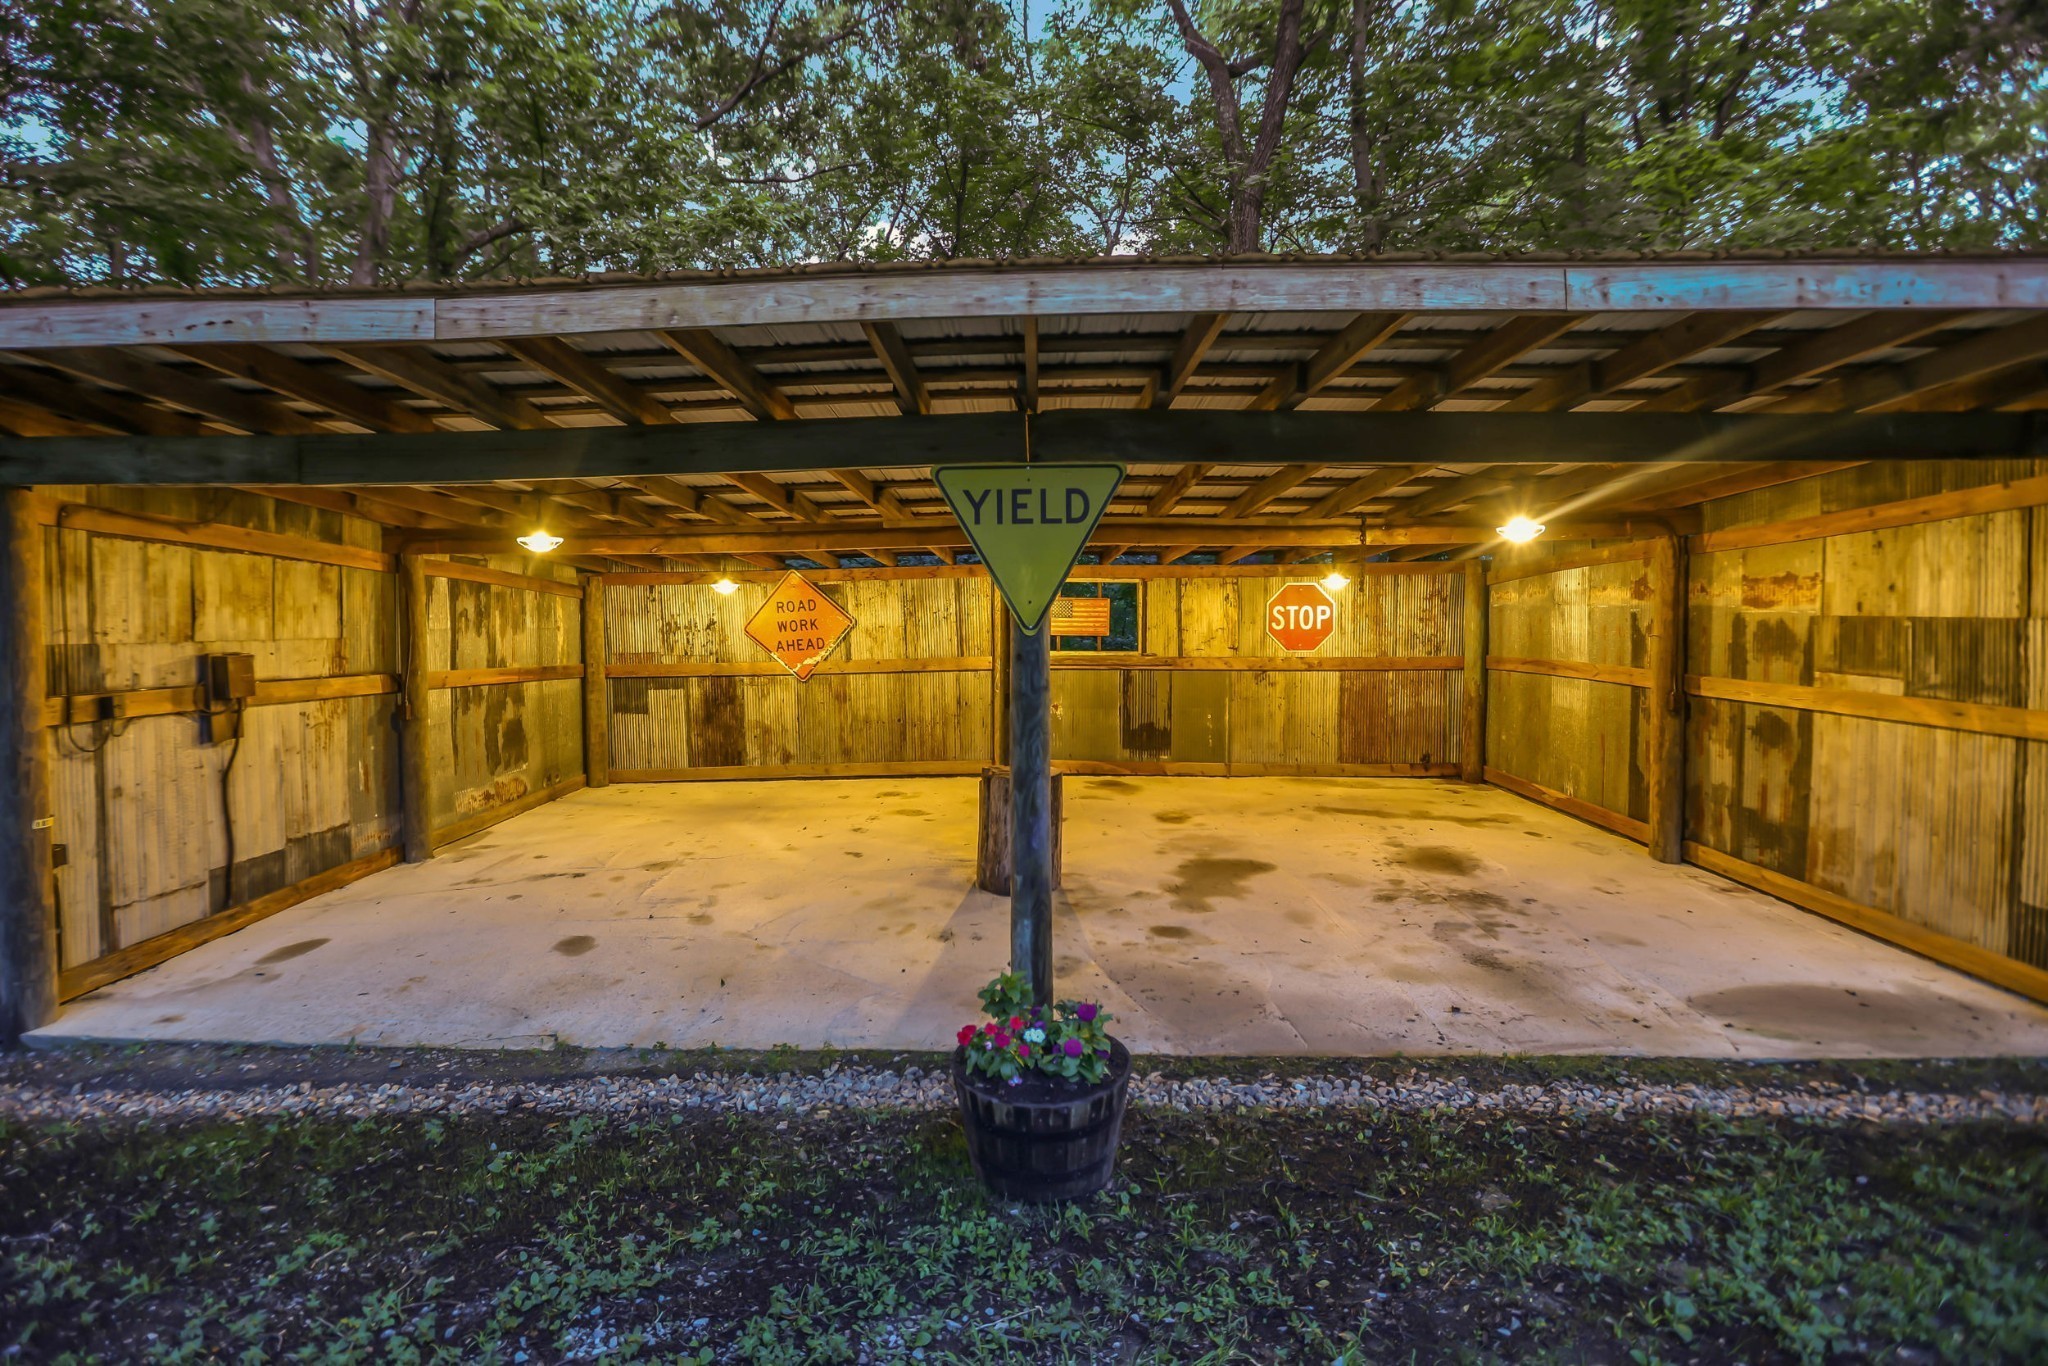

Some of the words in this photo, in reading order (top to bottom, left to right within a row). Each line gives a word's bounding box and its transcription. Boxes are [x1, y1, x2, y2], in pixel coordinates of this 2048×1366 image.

[962, 488, 1090, 525] YIELD
[776, 599, 816, 613] ROAD
[777, 618, 819, 632] WORK
[1271, 605, 1331, 630] STOP
[776, 637, 825, 652] AHEAD
